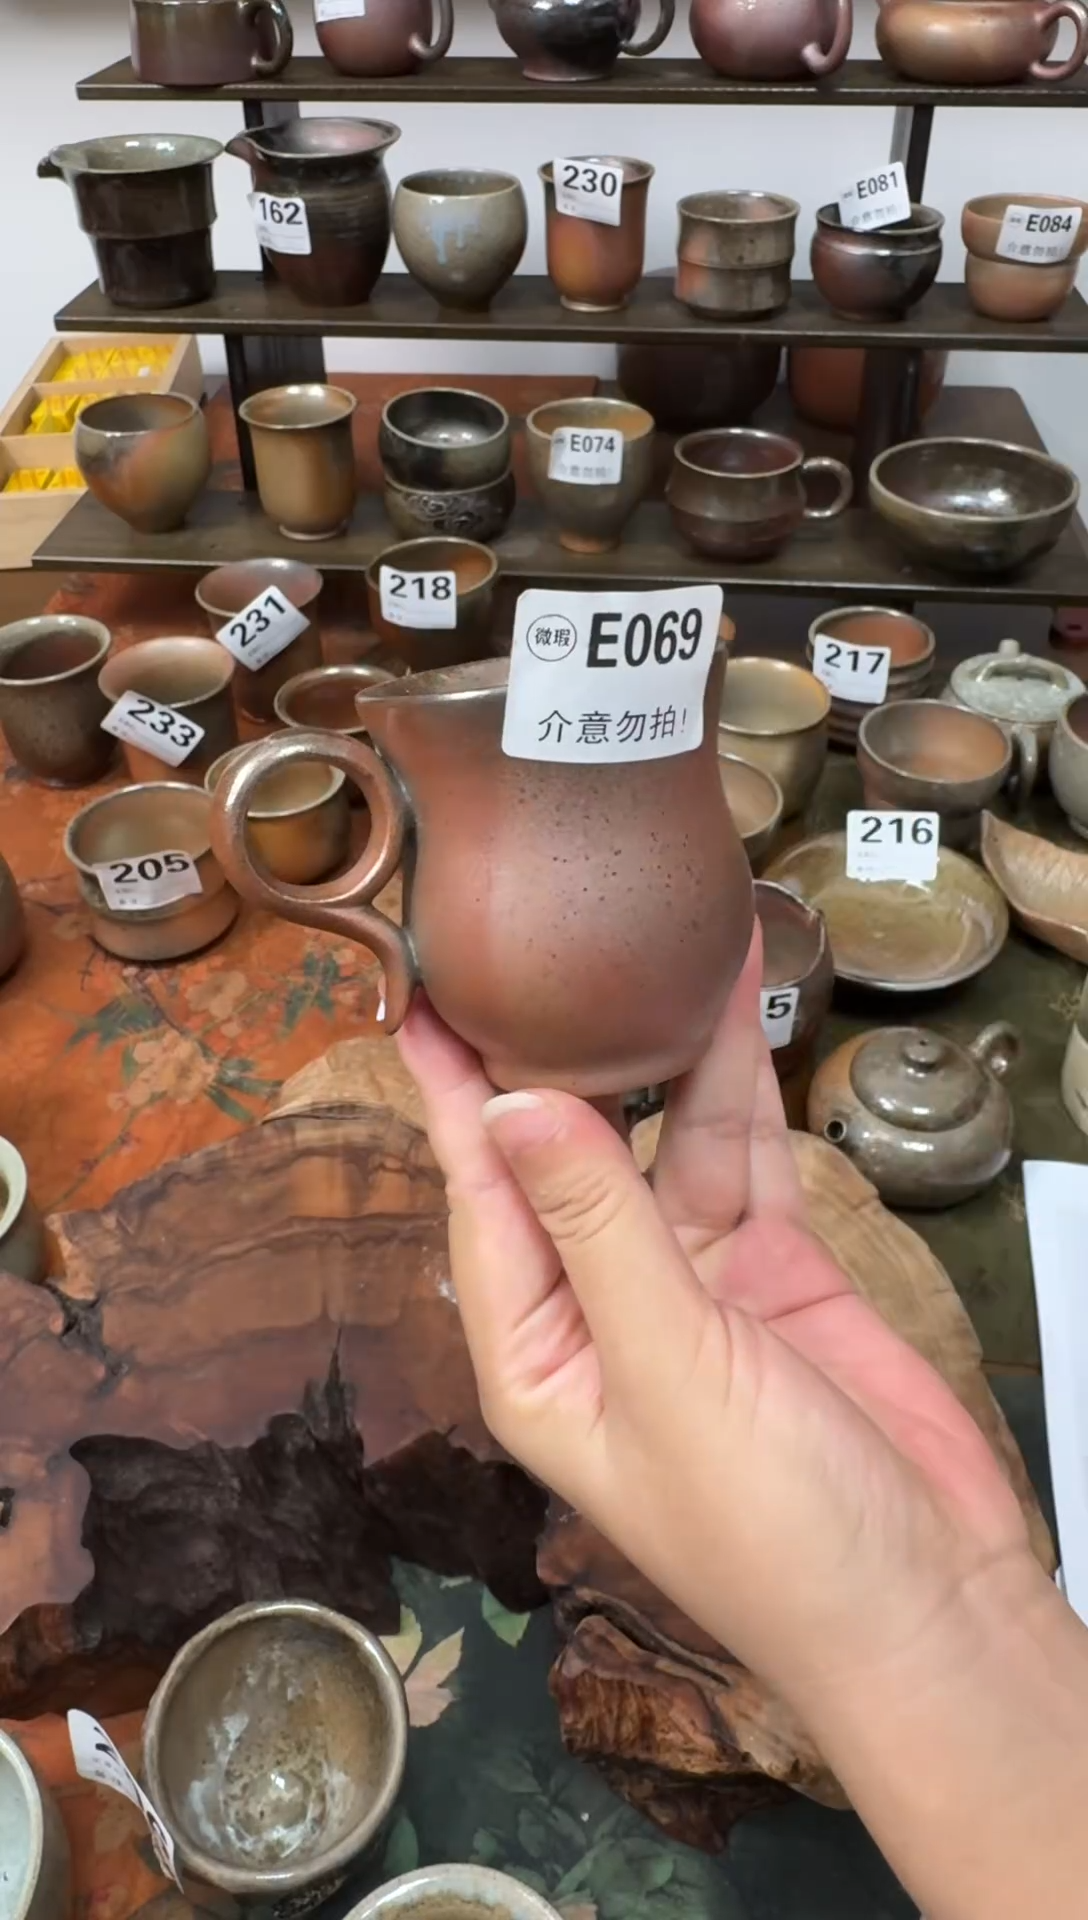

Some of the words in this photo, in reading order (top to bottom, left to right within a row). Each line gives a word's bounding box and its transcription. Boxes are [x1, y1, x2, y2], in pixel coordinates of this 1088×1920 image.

[563, 165, 617, 197] 230
[856, 171, 899, 200] E081
[259, 198, 303, 225] 162
[1025, 213, 1073, 233] E084
[570, 434, 616, 453] E074
[390, 574, 452, 600] 218
[230, 595, 286, 648] 231
[534, 626, 571, 648] 微瑕
[586, 608, 703, 668] E069
[824, 643, 885, 675] 217
[127, 699, 197, 748] 233
[860, 816, 934, 845] 216
[109, 853, 190, 883] 205
